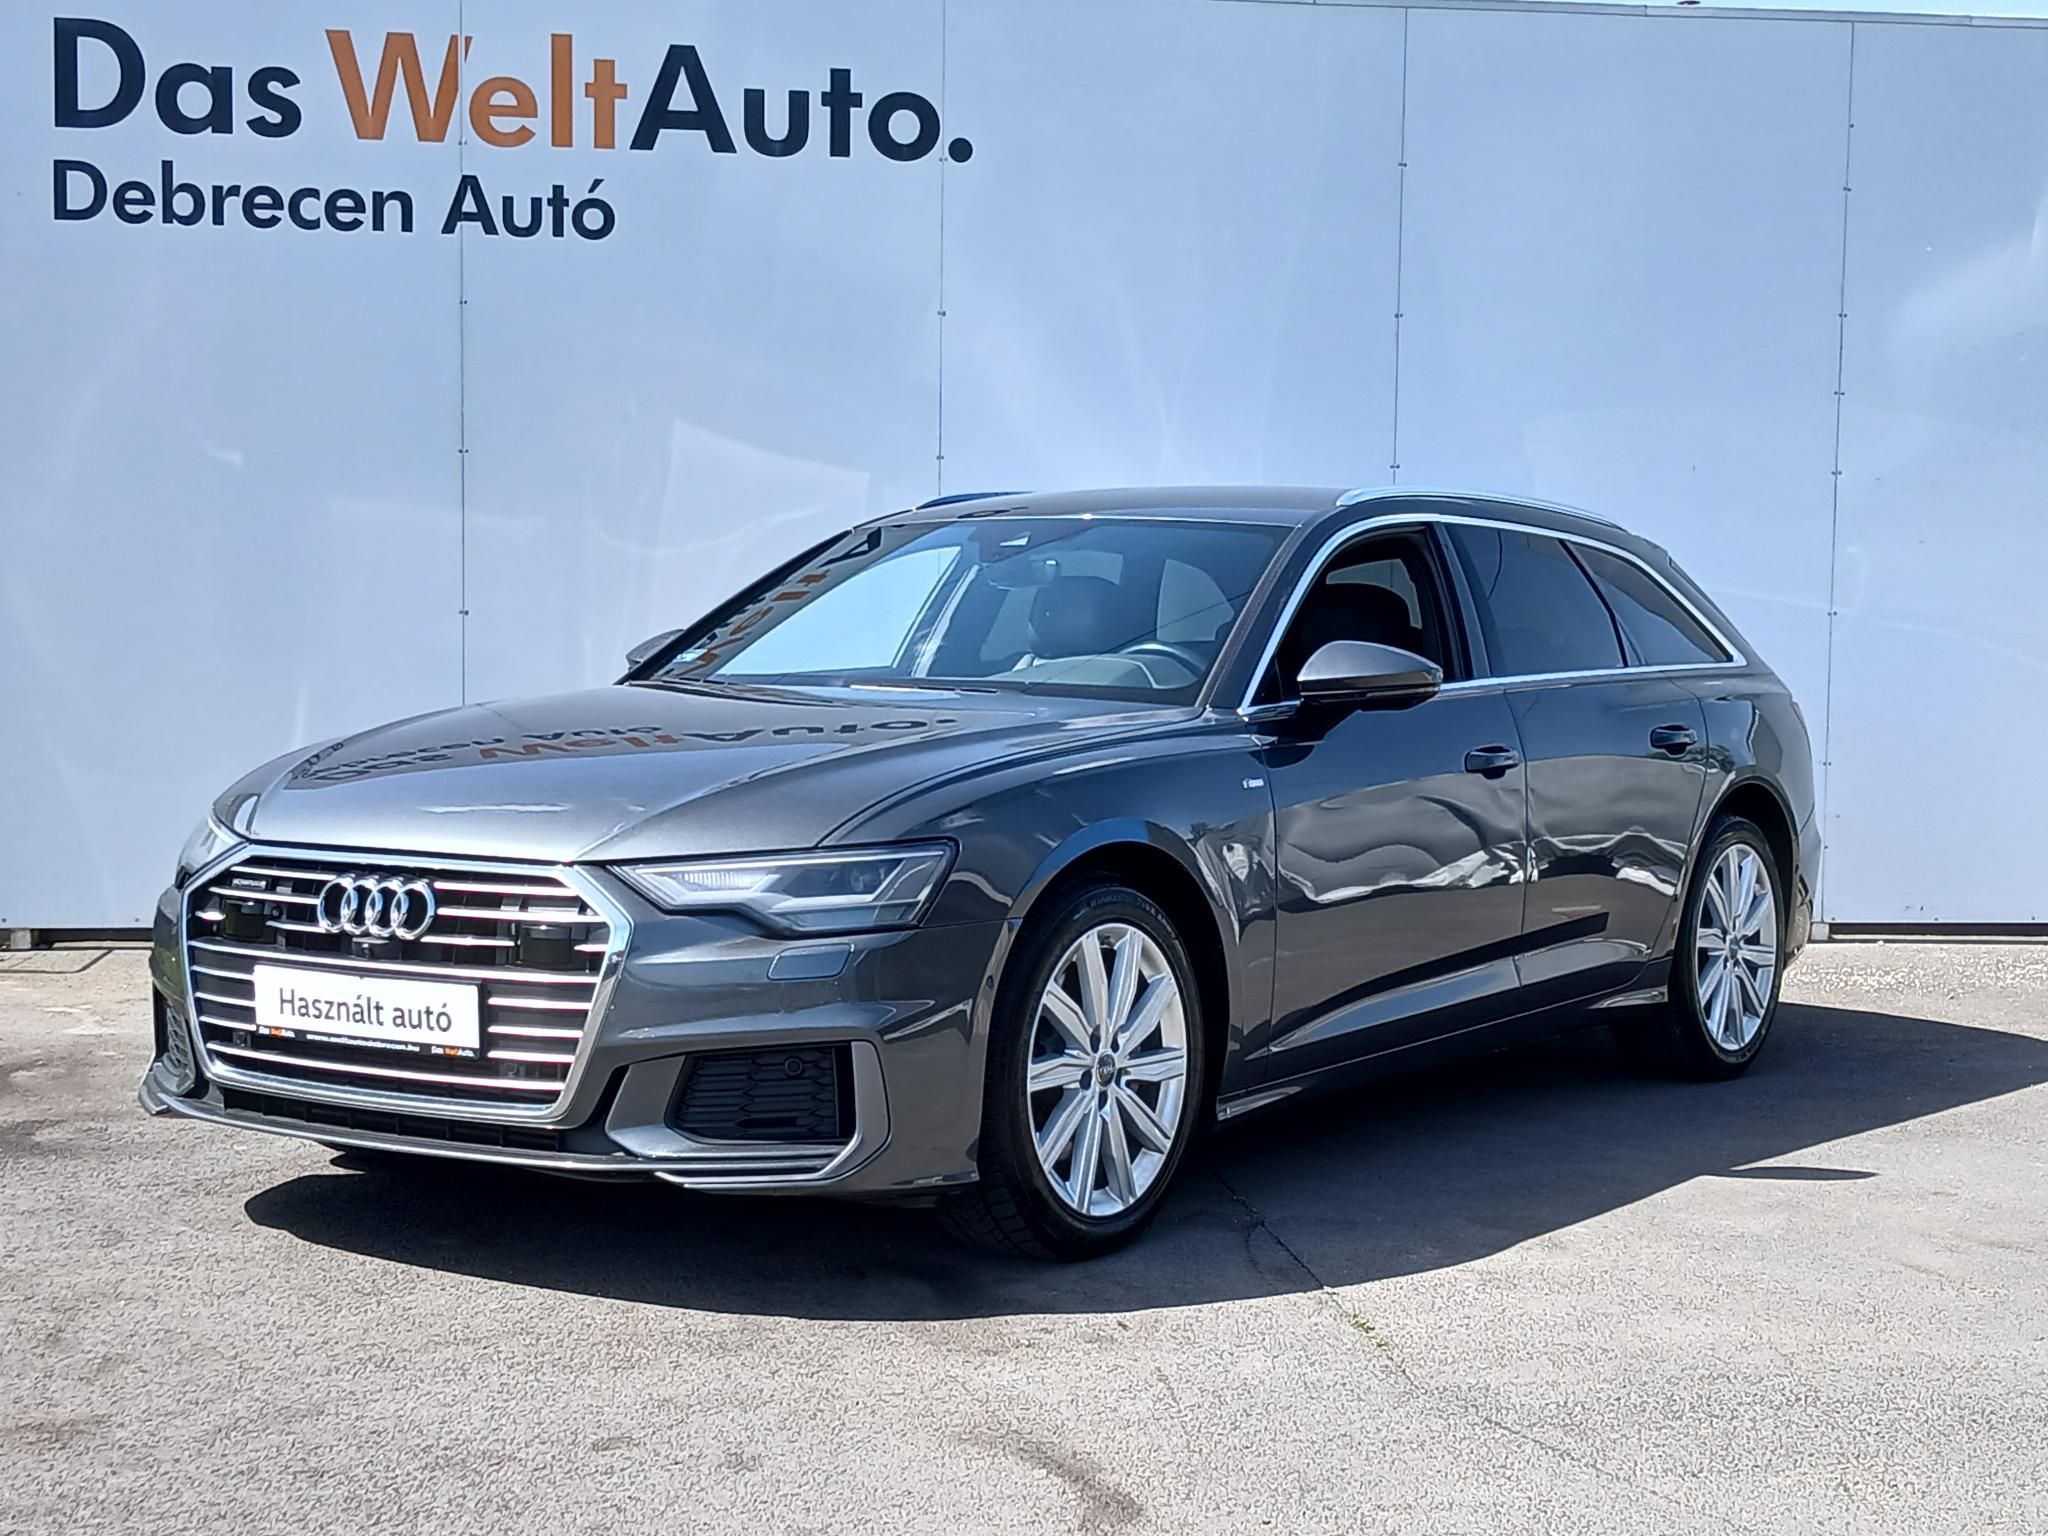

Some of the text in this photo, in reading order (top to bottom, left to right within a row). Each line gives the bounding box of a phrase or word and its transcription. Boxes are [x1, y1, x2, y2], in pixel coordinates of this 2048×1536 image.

[53, 17, 973, 163] Das WeltAuto.
[53, 159, 615, 241] Debrecen Autó
[279, 988, 453, 1033] Használt autó
